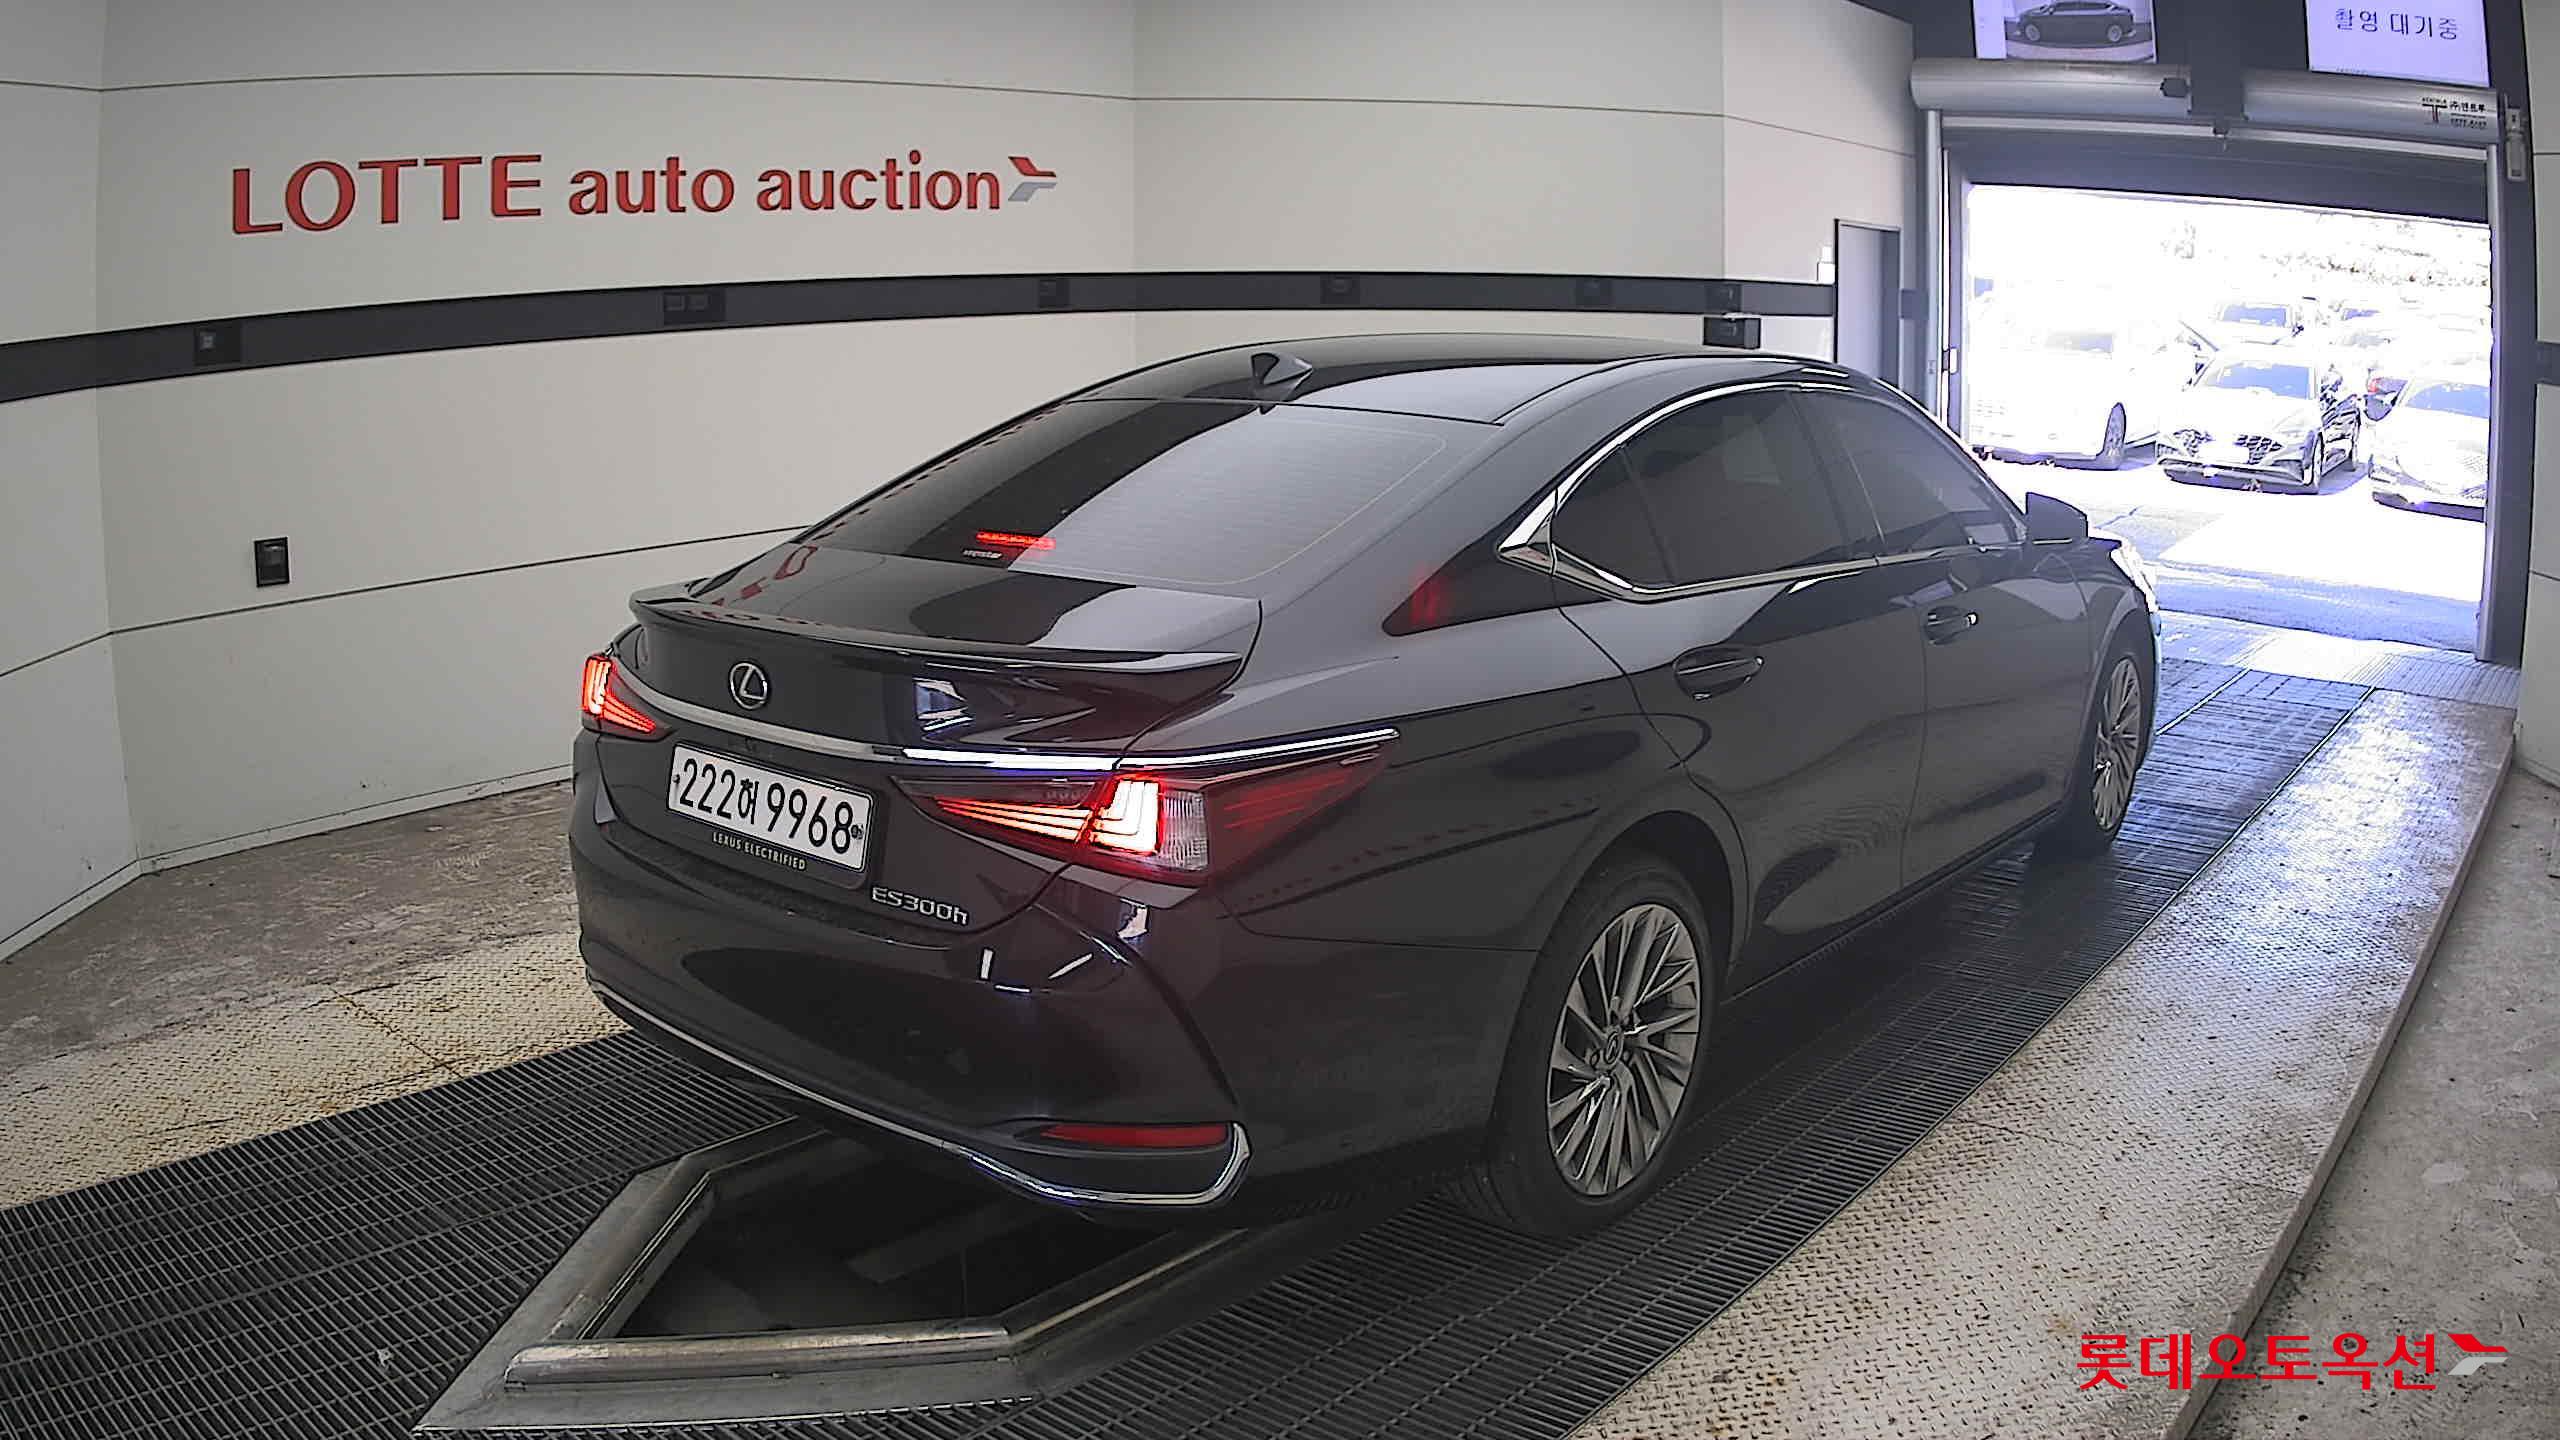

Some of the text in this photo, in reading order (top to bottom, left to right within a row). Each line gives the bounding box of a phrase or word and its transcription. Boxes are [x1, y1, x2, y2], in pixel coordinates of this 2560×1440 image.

[2336, 8, 2458, 41] 촬영 대기중
[232, 150, 1001, 235] LOTTE auto auction
[679, 758, 853, 855] 222허 9968
[712, 831, 807, 871] LEXUS ELECTRIFIED
[872, 887, 967, 925] ES300h
